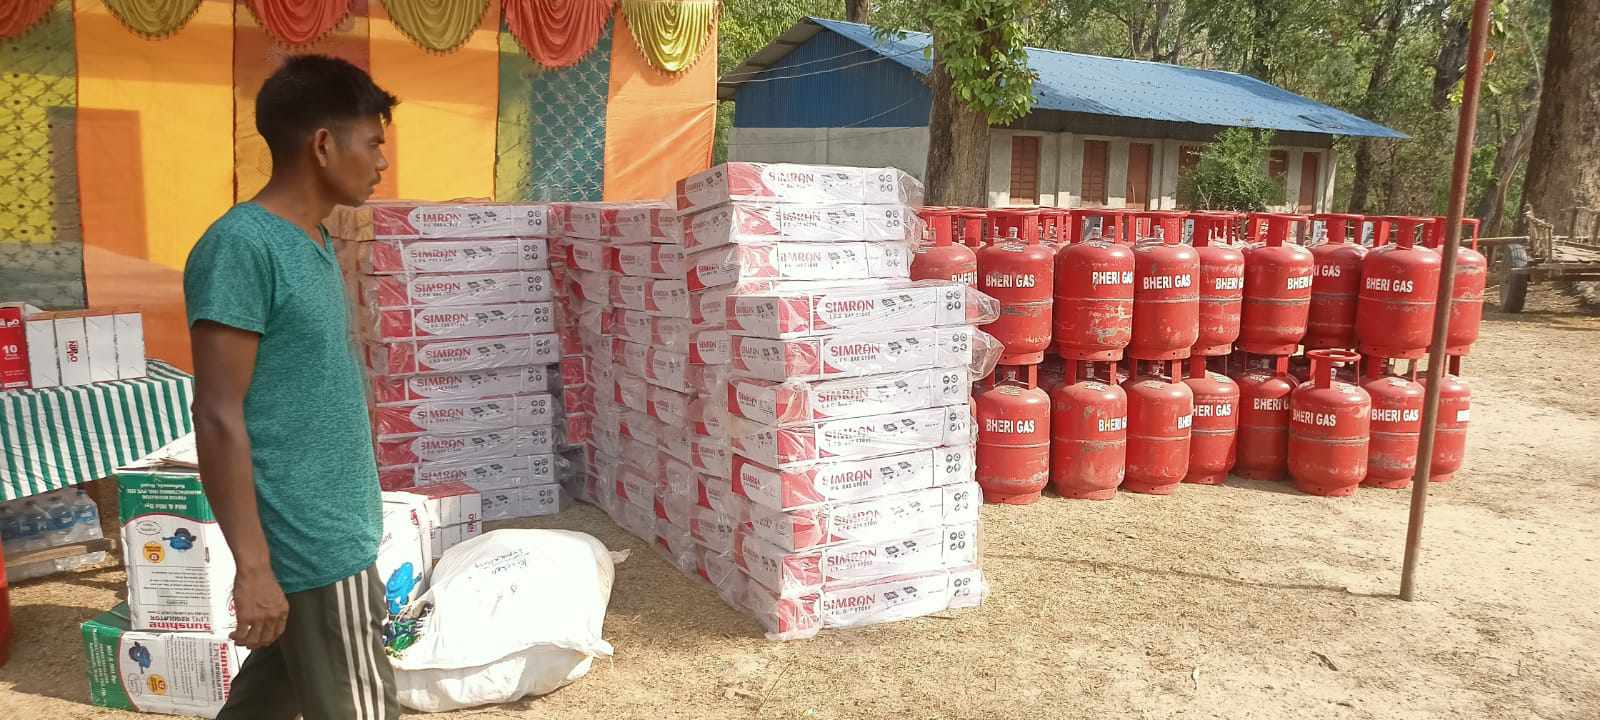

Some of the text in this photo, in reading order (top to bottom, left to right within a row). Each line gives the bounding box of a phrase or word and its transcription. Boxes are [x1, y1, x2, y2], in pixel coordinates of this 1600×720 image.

[1321, 265, 1341, 277] GAS
[985, 274, 1013, 287] BHERI
[1016, 274, 1035, 287] GAS
[1092, 272, 1120, 285] BHERI
[1143, 274, 1191, 289] BHERI GAS
[1366, 277, 1414, 293] BHERI GAS
[825, 299, 875, 313] SIMRAN
[423, 313, 469, 323] SIMRAN
[2, 344, 18, 354] 10
[425, 347, 471, 358] SIMRAN
[830, 343, 881, 357] SIMRAN
[416, 375, 463, 387] SIMRAN
[1192, 403, 1231, 417] HERI GAS
[1254, 398, 1281, 411] BHERI
[1293, 409, 1336, 427] BHERI GAS
[1371, 408, 1419, 422] BHERI GAS
[985, 419, 1035, 433] BHERI GAS
[823, 594, 876, 610] SIMRAN
[149, 621, 212, 631] Sunshine
